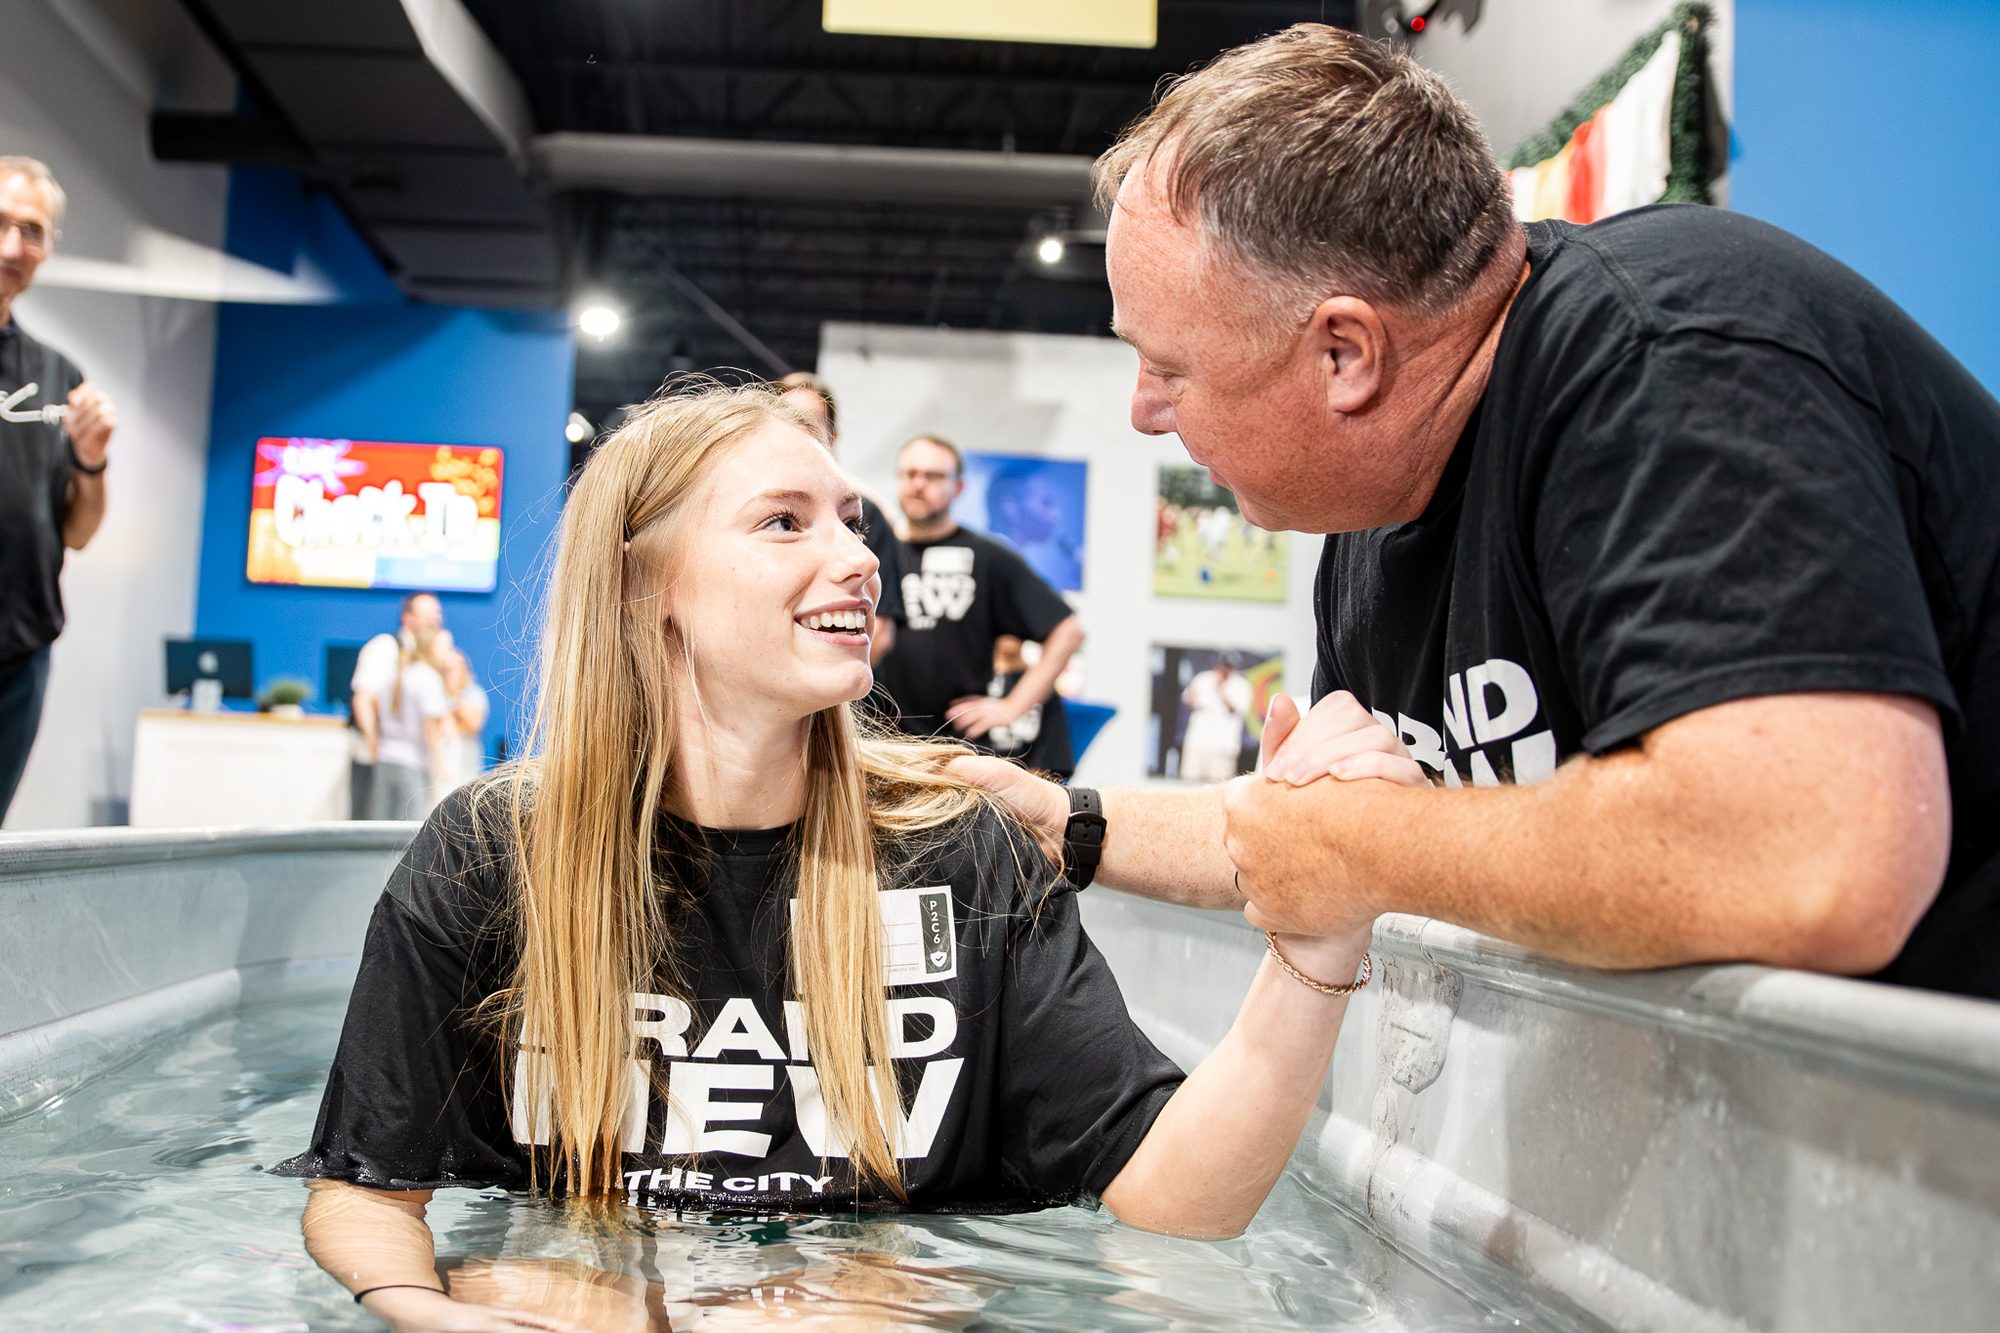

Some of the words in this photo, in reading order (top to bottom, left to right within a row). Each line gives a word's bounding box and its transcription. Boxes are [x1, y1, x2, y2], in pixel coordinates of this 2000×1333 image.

[929, 900, 941, 944] P2C6
[624, 1167, 713, 1193] THE
[722, 1172, 833, 1193] CITY
